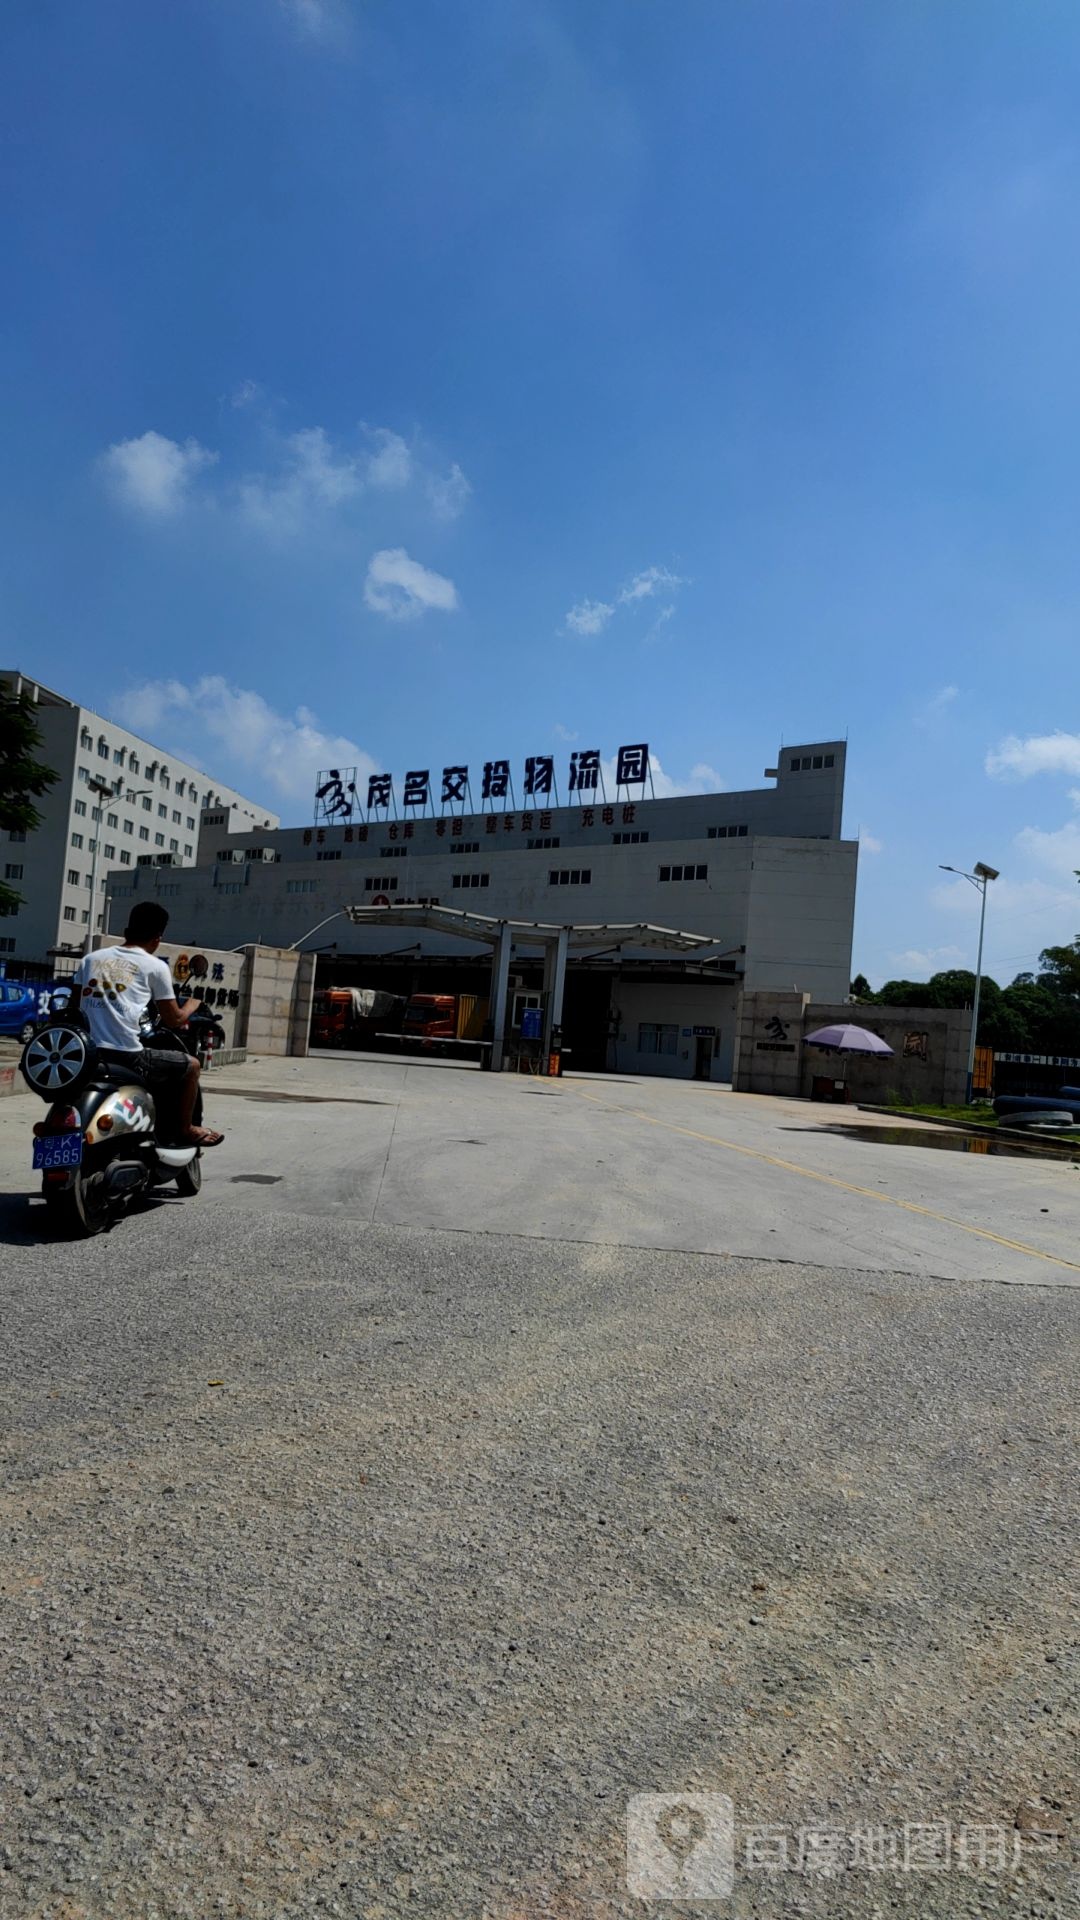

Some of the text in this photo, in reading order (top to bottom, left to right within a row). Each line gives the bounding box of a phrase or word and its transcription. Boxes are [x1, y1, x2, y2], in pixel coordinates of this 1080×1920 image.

[367, 744, 648, 807] 茂名交投物流园
[389, 822, 414, 841] 仓库
[486, 811, 551, 833] 整车货运
[582, 804, 635, 827] 充电桩
[36, 1148, 79, 1167] 96585
